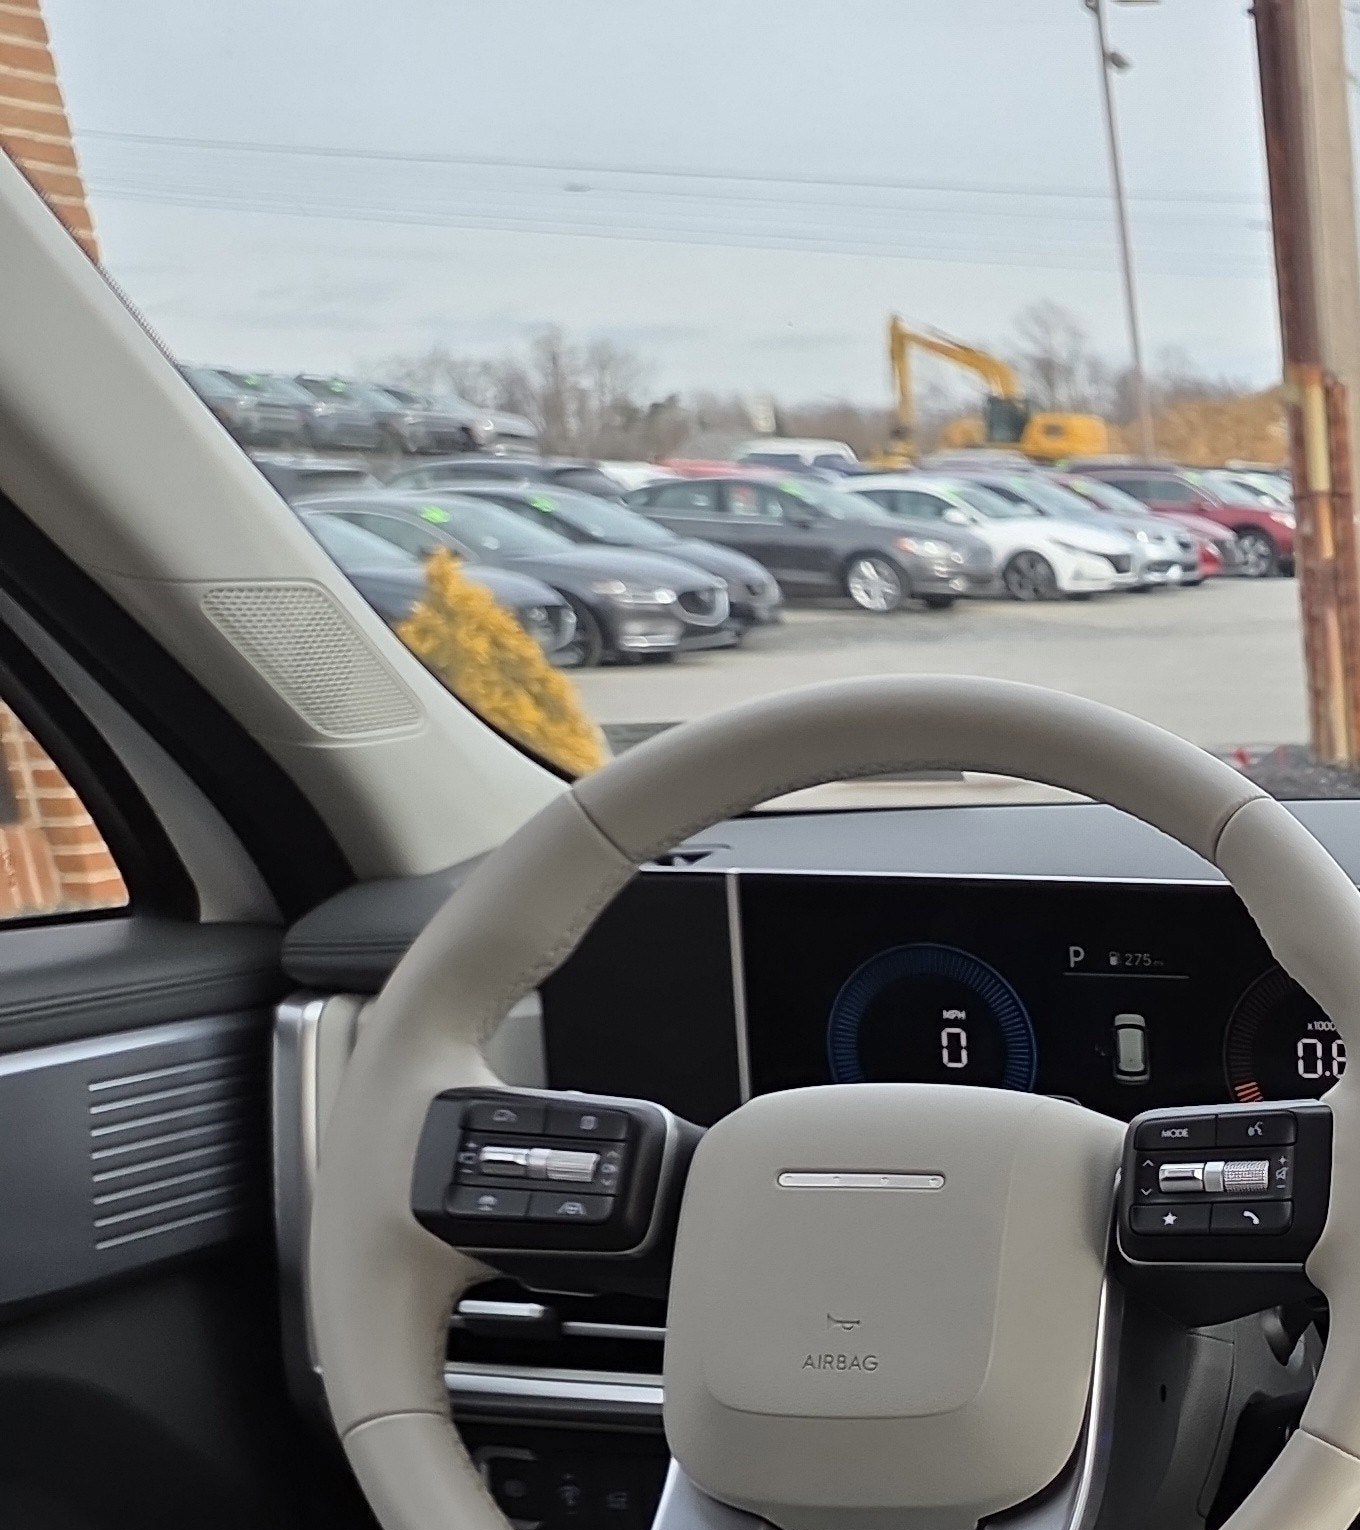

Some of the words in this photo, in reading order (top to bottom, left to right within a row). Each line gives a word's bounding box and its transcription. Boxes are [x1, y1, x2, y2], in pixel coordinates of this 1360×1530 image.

[1068, 945, 1085, 968] P
[1124, 953, 1152, 967] 275
[942, 1009, 966, 1020] MPH
[941, 1027, 968, 1068] 0
[1161, 1127, 1189, 1138] MODE
[802, 1354, 879, 1371] AIRBAG
